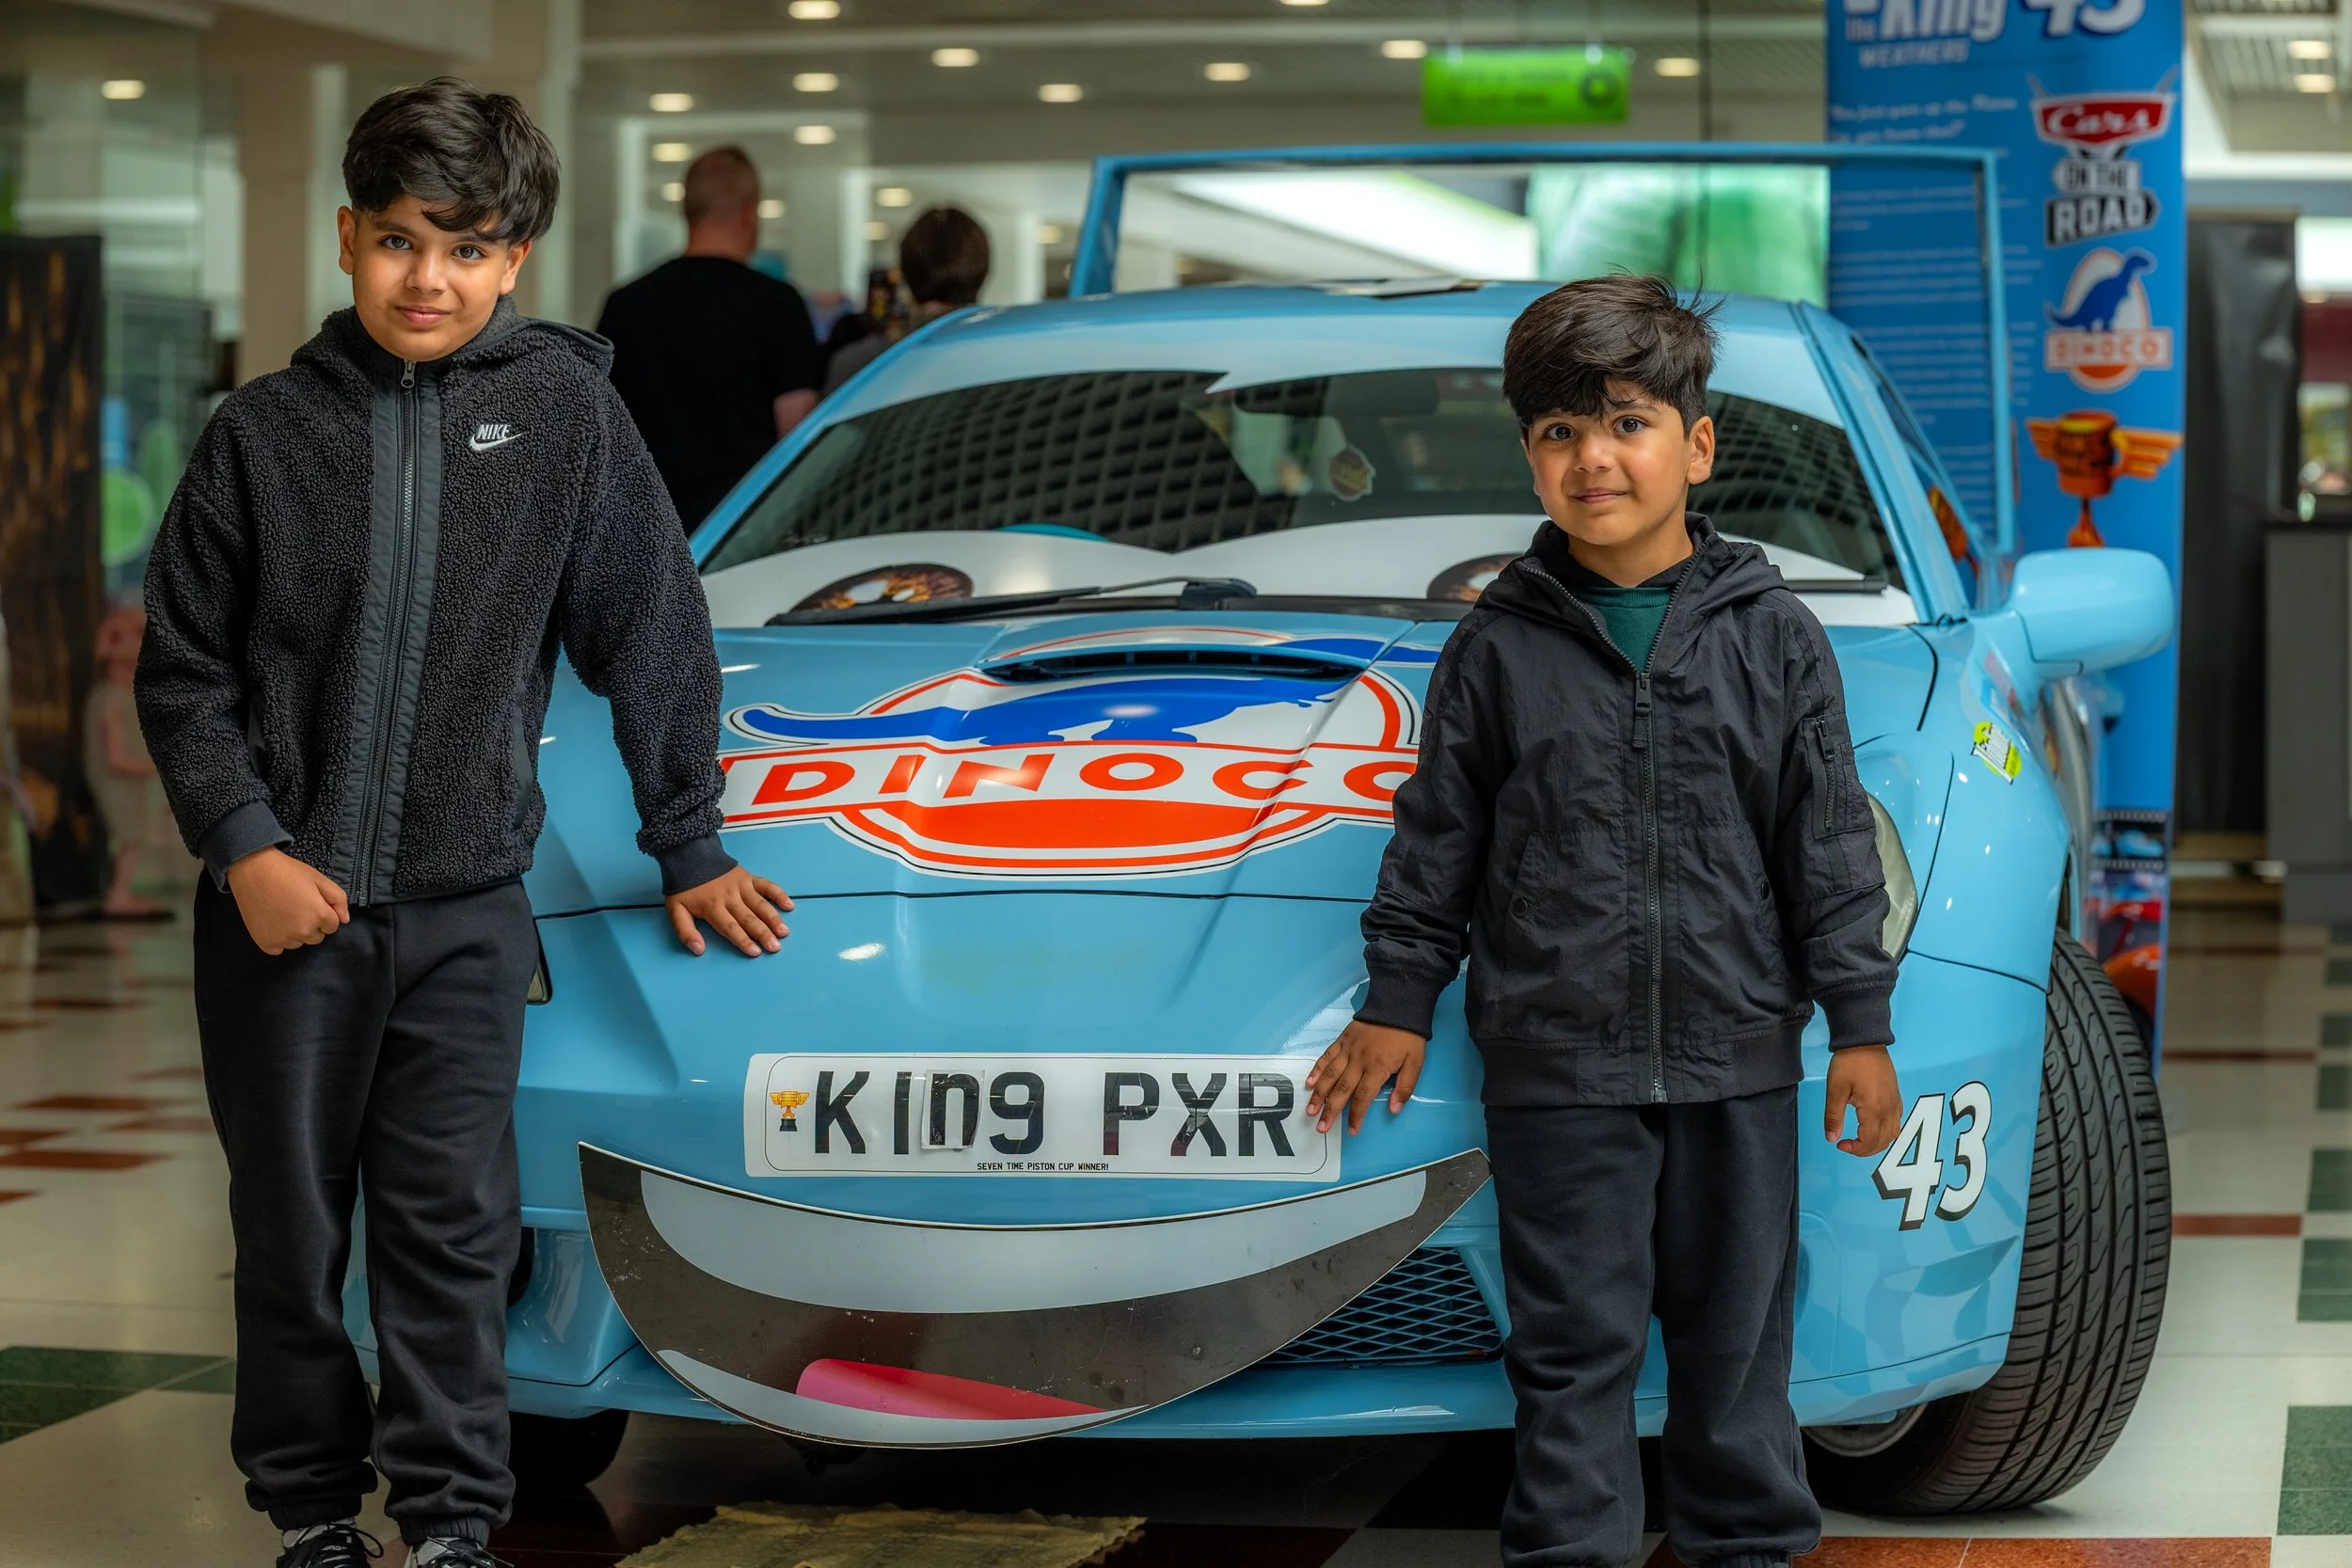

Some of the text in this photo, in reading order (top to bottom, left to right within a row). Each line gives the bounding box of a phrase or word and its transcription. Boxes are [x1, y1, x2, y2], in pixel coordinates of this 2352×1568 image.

[1859, 39, 1970, 69] WEATHERS
[2044, 103, 2153, 137] Cars
[2054, 189, 2146, 242] ROAD
[477, 424, 509, 439] NIKE
[751, 752, 1418, 805] DINOCO
[1103, 1071, 1296, 1157] PXR
[977, 1162, 1109, 1171] SEVEN TIME PISTON CUP WINNER!
[1871, 1081, 1993, 1231] 43
